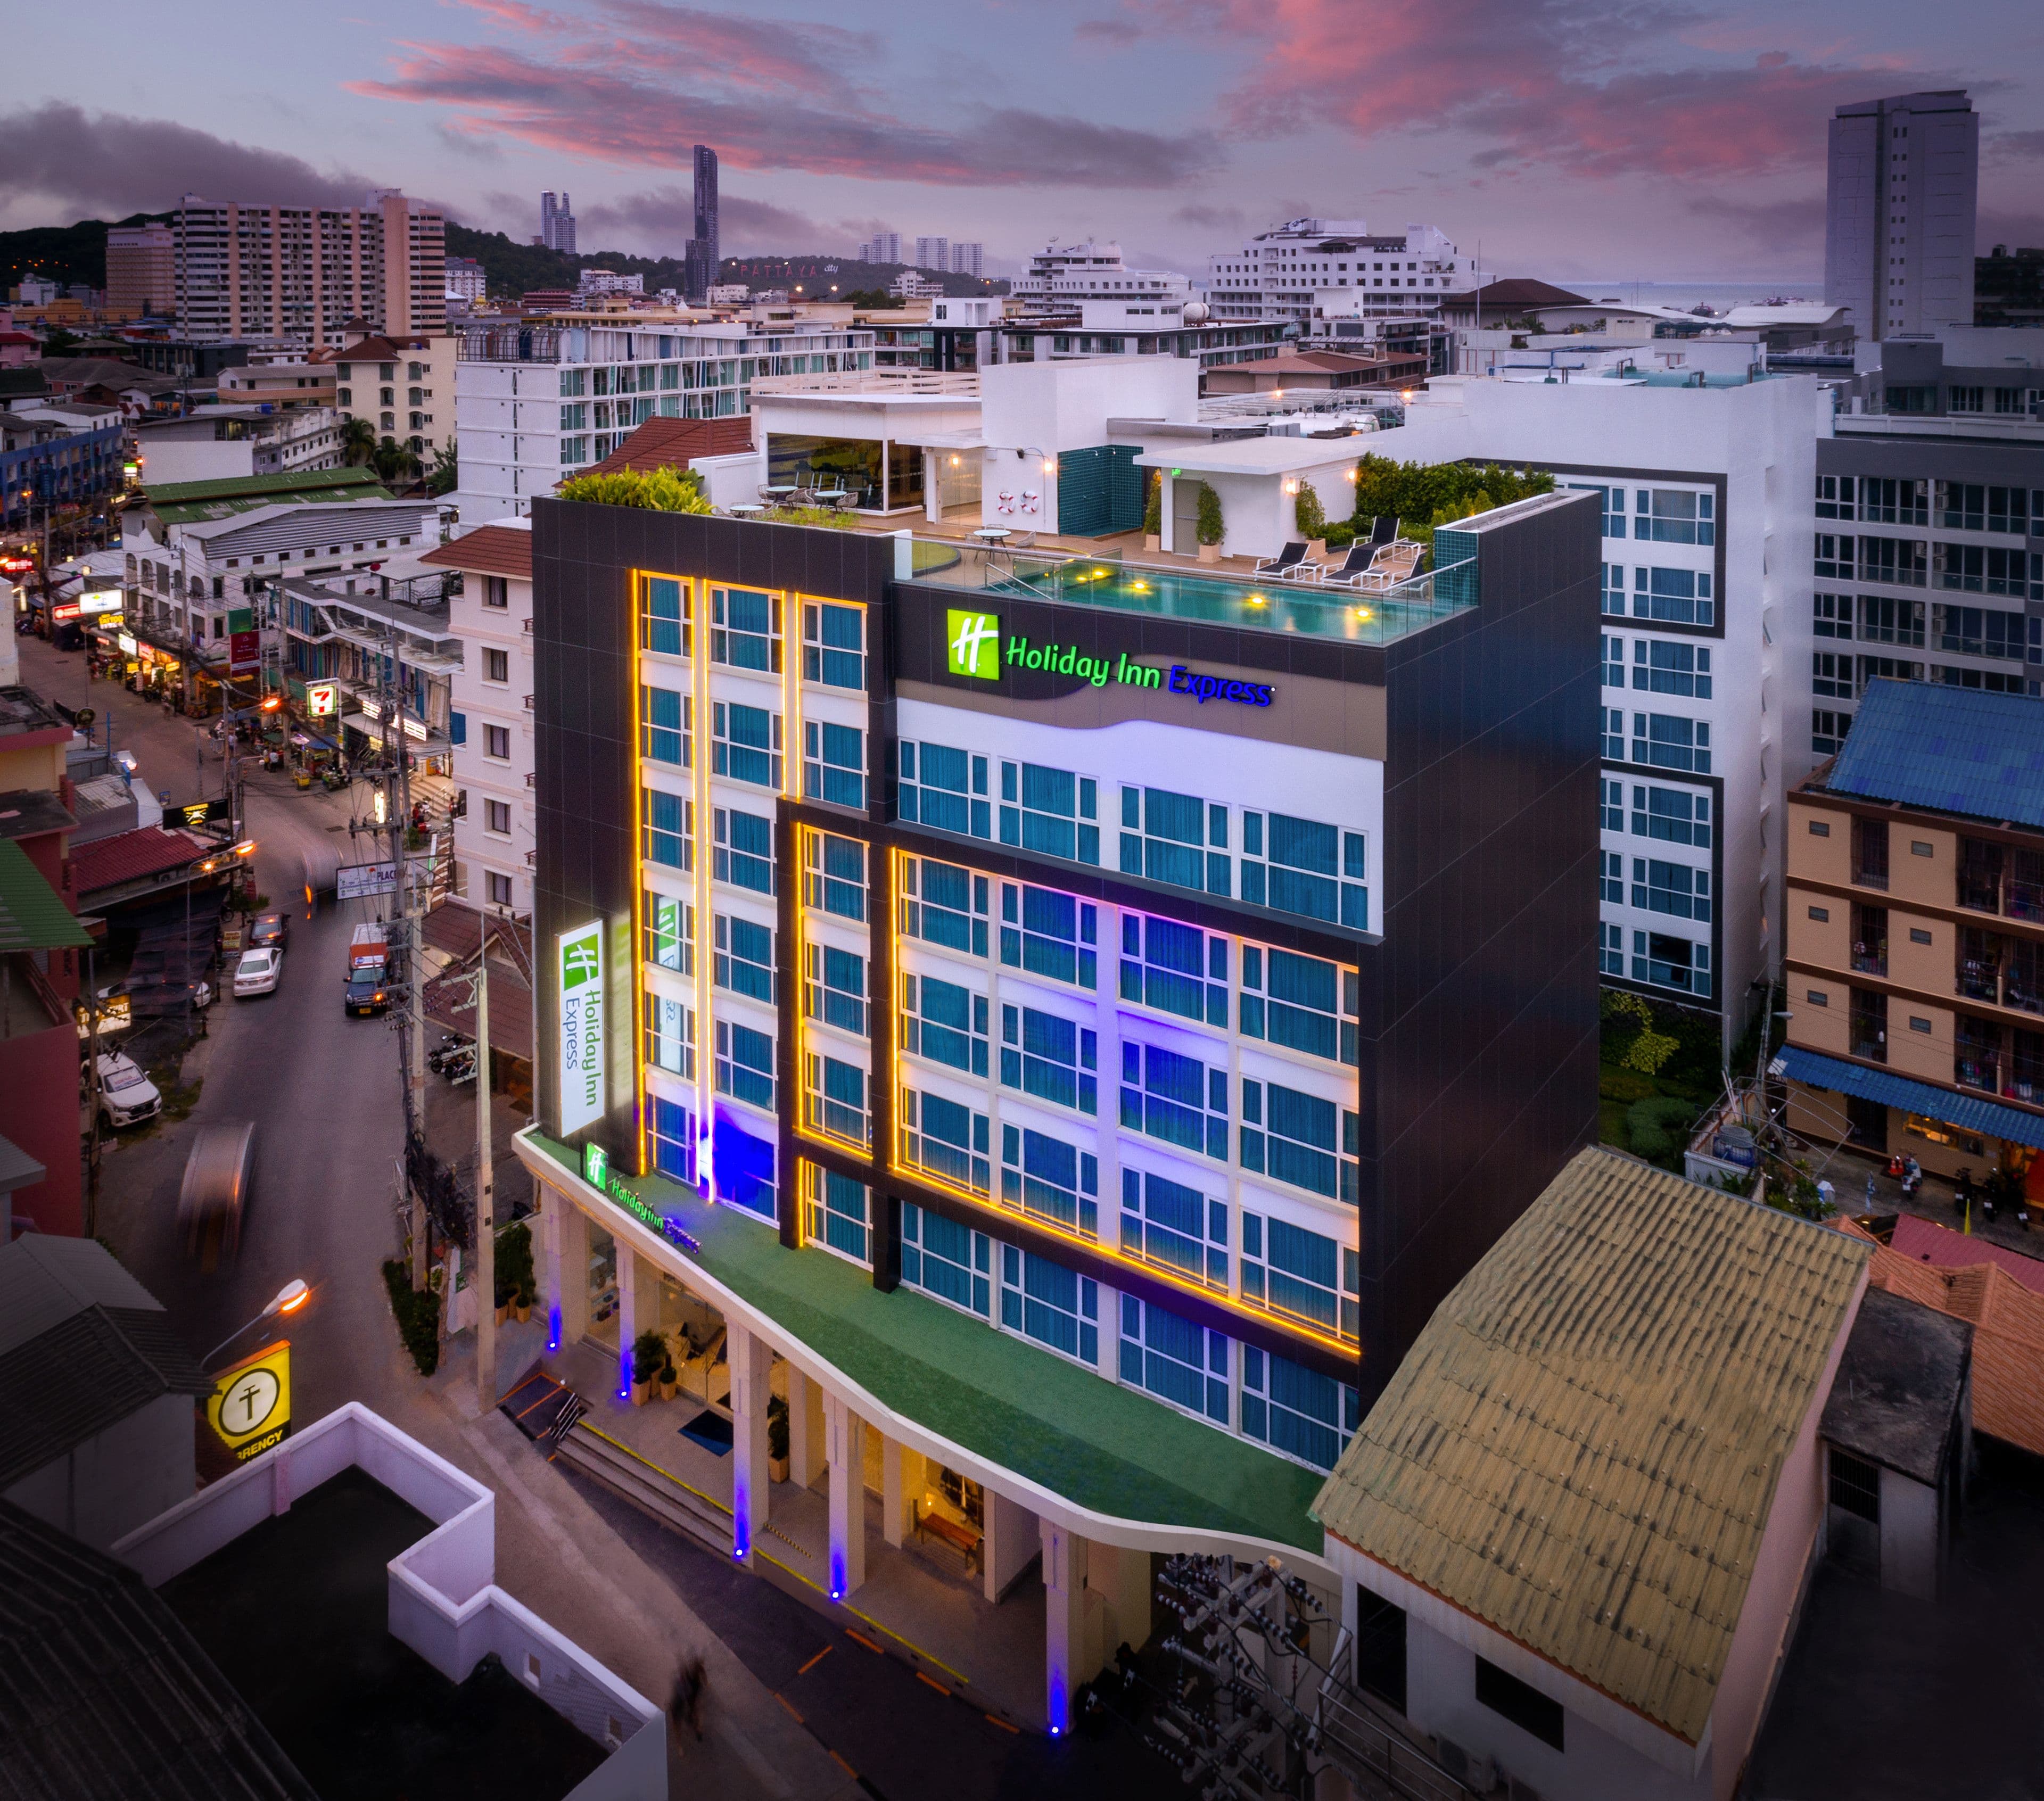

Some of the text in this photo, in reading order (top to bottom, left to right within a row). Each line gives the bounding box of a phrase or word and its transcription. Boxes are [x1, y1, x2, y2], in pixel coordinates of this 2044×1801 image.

[740, 265, 818, 277] PATTAYA
[1005, 636, 1271, 707] Holiday Inn Express
[563, 997, 580, 1070] Express
[582, 990, 601, 1106] Holiday Inn
[612, 1178, 647, 1221] Holiday
